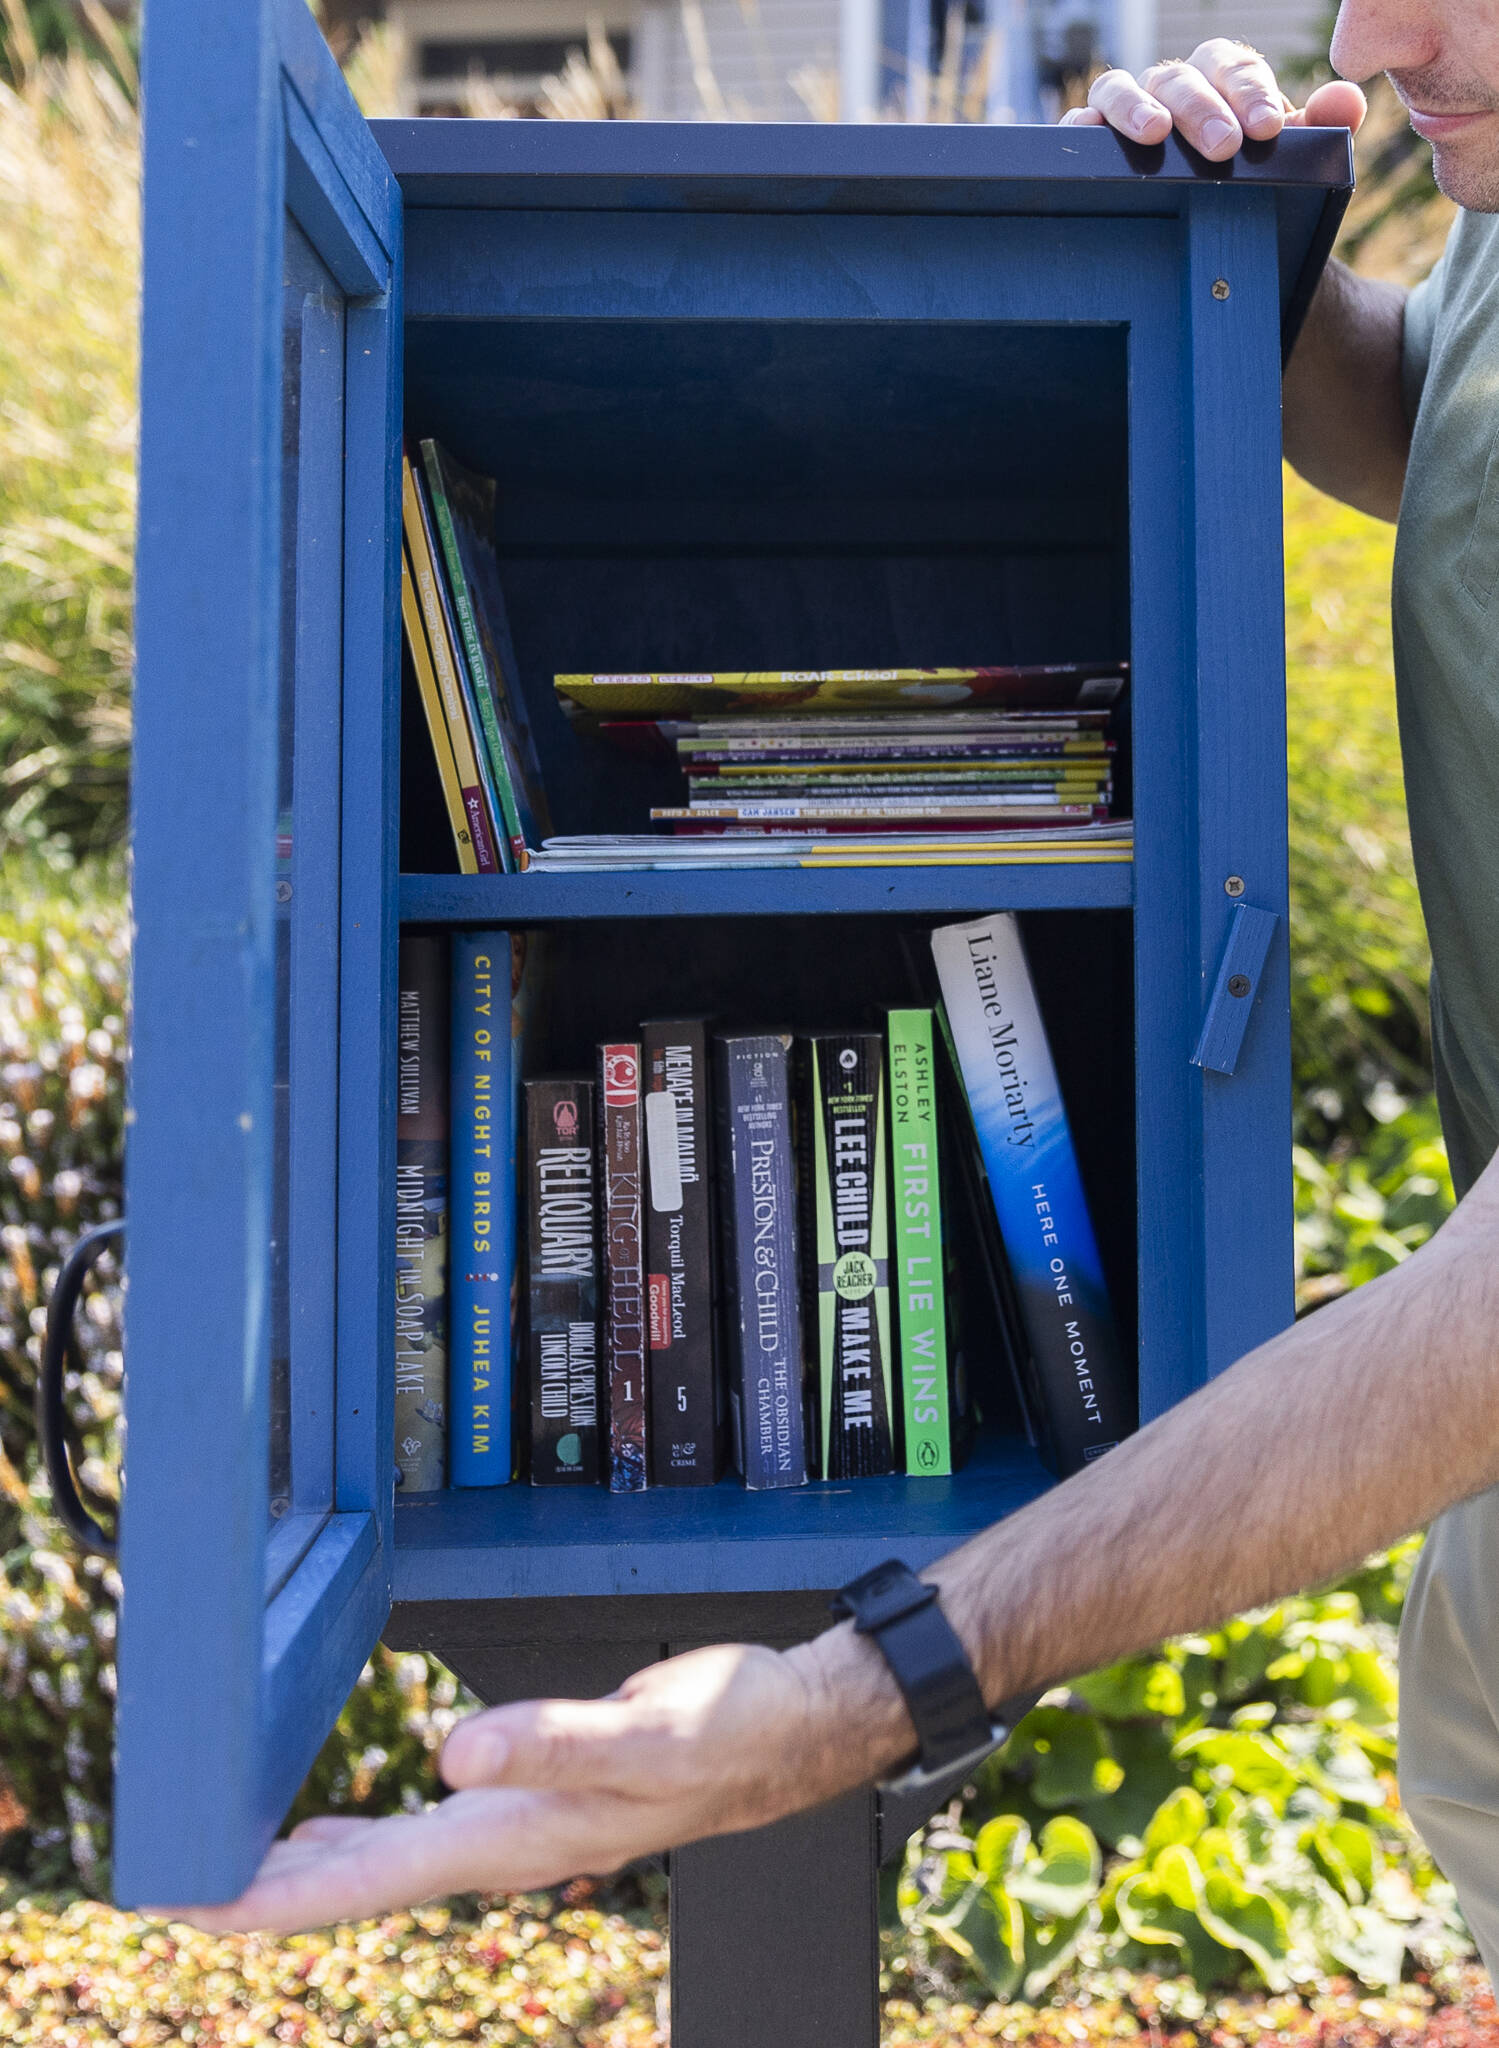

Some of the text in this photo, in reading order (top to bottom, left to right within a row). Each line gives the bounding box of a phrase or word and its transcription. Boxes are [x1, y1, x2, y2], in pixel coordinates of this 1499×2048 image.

[419, 569, 432, 589] The
[443, 677, 460, 720] Carnival
[456, 595, 485, 688] HIGH TIDE IN HAWAII
[742, 808, 796, 816] CAM JANSEN
[399, 991, 420, 1114] MATTHEW SULLIVAN
[664, 1045, 693, 1104] MENACE
[736, 1052, 779, 1060] FICTION
[893, 1044, 909, 1123] ELSTON
[914, 1042, 929, 1122] ASHLEY
[966, 931, 1036, 1152] Liane Moriarty
[472, 955, 490, 1253] CITY OF NIGHT BIRDS
[556, 1127, 577, 1135] TOR
[674, 1107, 694, 1122] IN
[536, 1147, 593, 1278] RELIQUARY
[834, 1118, 868, 1245] LEE CHILD
[395, 1164, 424, 1394] MIDNIGHT IN SOAP LAKE
[609, 1172, 640, 1371] KING OF HELL
[666, 1214, 686, 1339] Torquil MacLeod
[749, 1139, 781, 1351] PRESTON & CHILD
[837, 1273, 872, 1288] REACHER
[843, 1261, 865, 1274] JACK
[901, 1141, 939, 1424] FIRST LIE WINS
[649, 1284, 661, 1341] Goodwill
[840, 1306, 870, 1381] MAKE
[1031, 1183, 1059, 1247] HERE
[1049, 1257, 1073, 1306] ONE
[1064, 1320, 1102, 1425] MOMENT
[472, 1303, 490, 1454] JUHEA KIM
[539, 1333, 568, 1418] LINCOLN CHILD
[567, 1321, 596, 1427] DOUGLAS PRESTON
[623, 1380, 633, 1401] 1
[677, 1386, 687, 1412] 5
[756, 1378, 772, 1455] CHAMBER
[773, 1358, 790, 1471] THE OBSIDIAN
[842, 1389, 871, 1430] ME
[671, 1459, 697, 1467] CRIME
